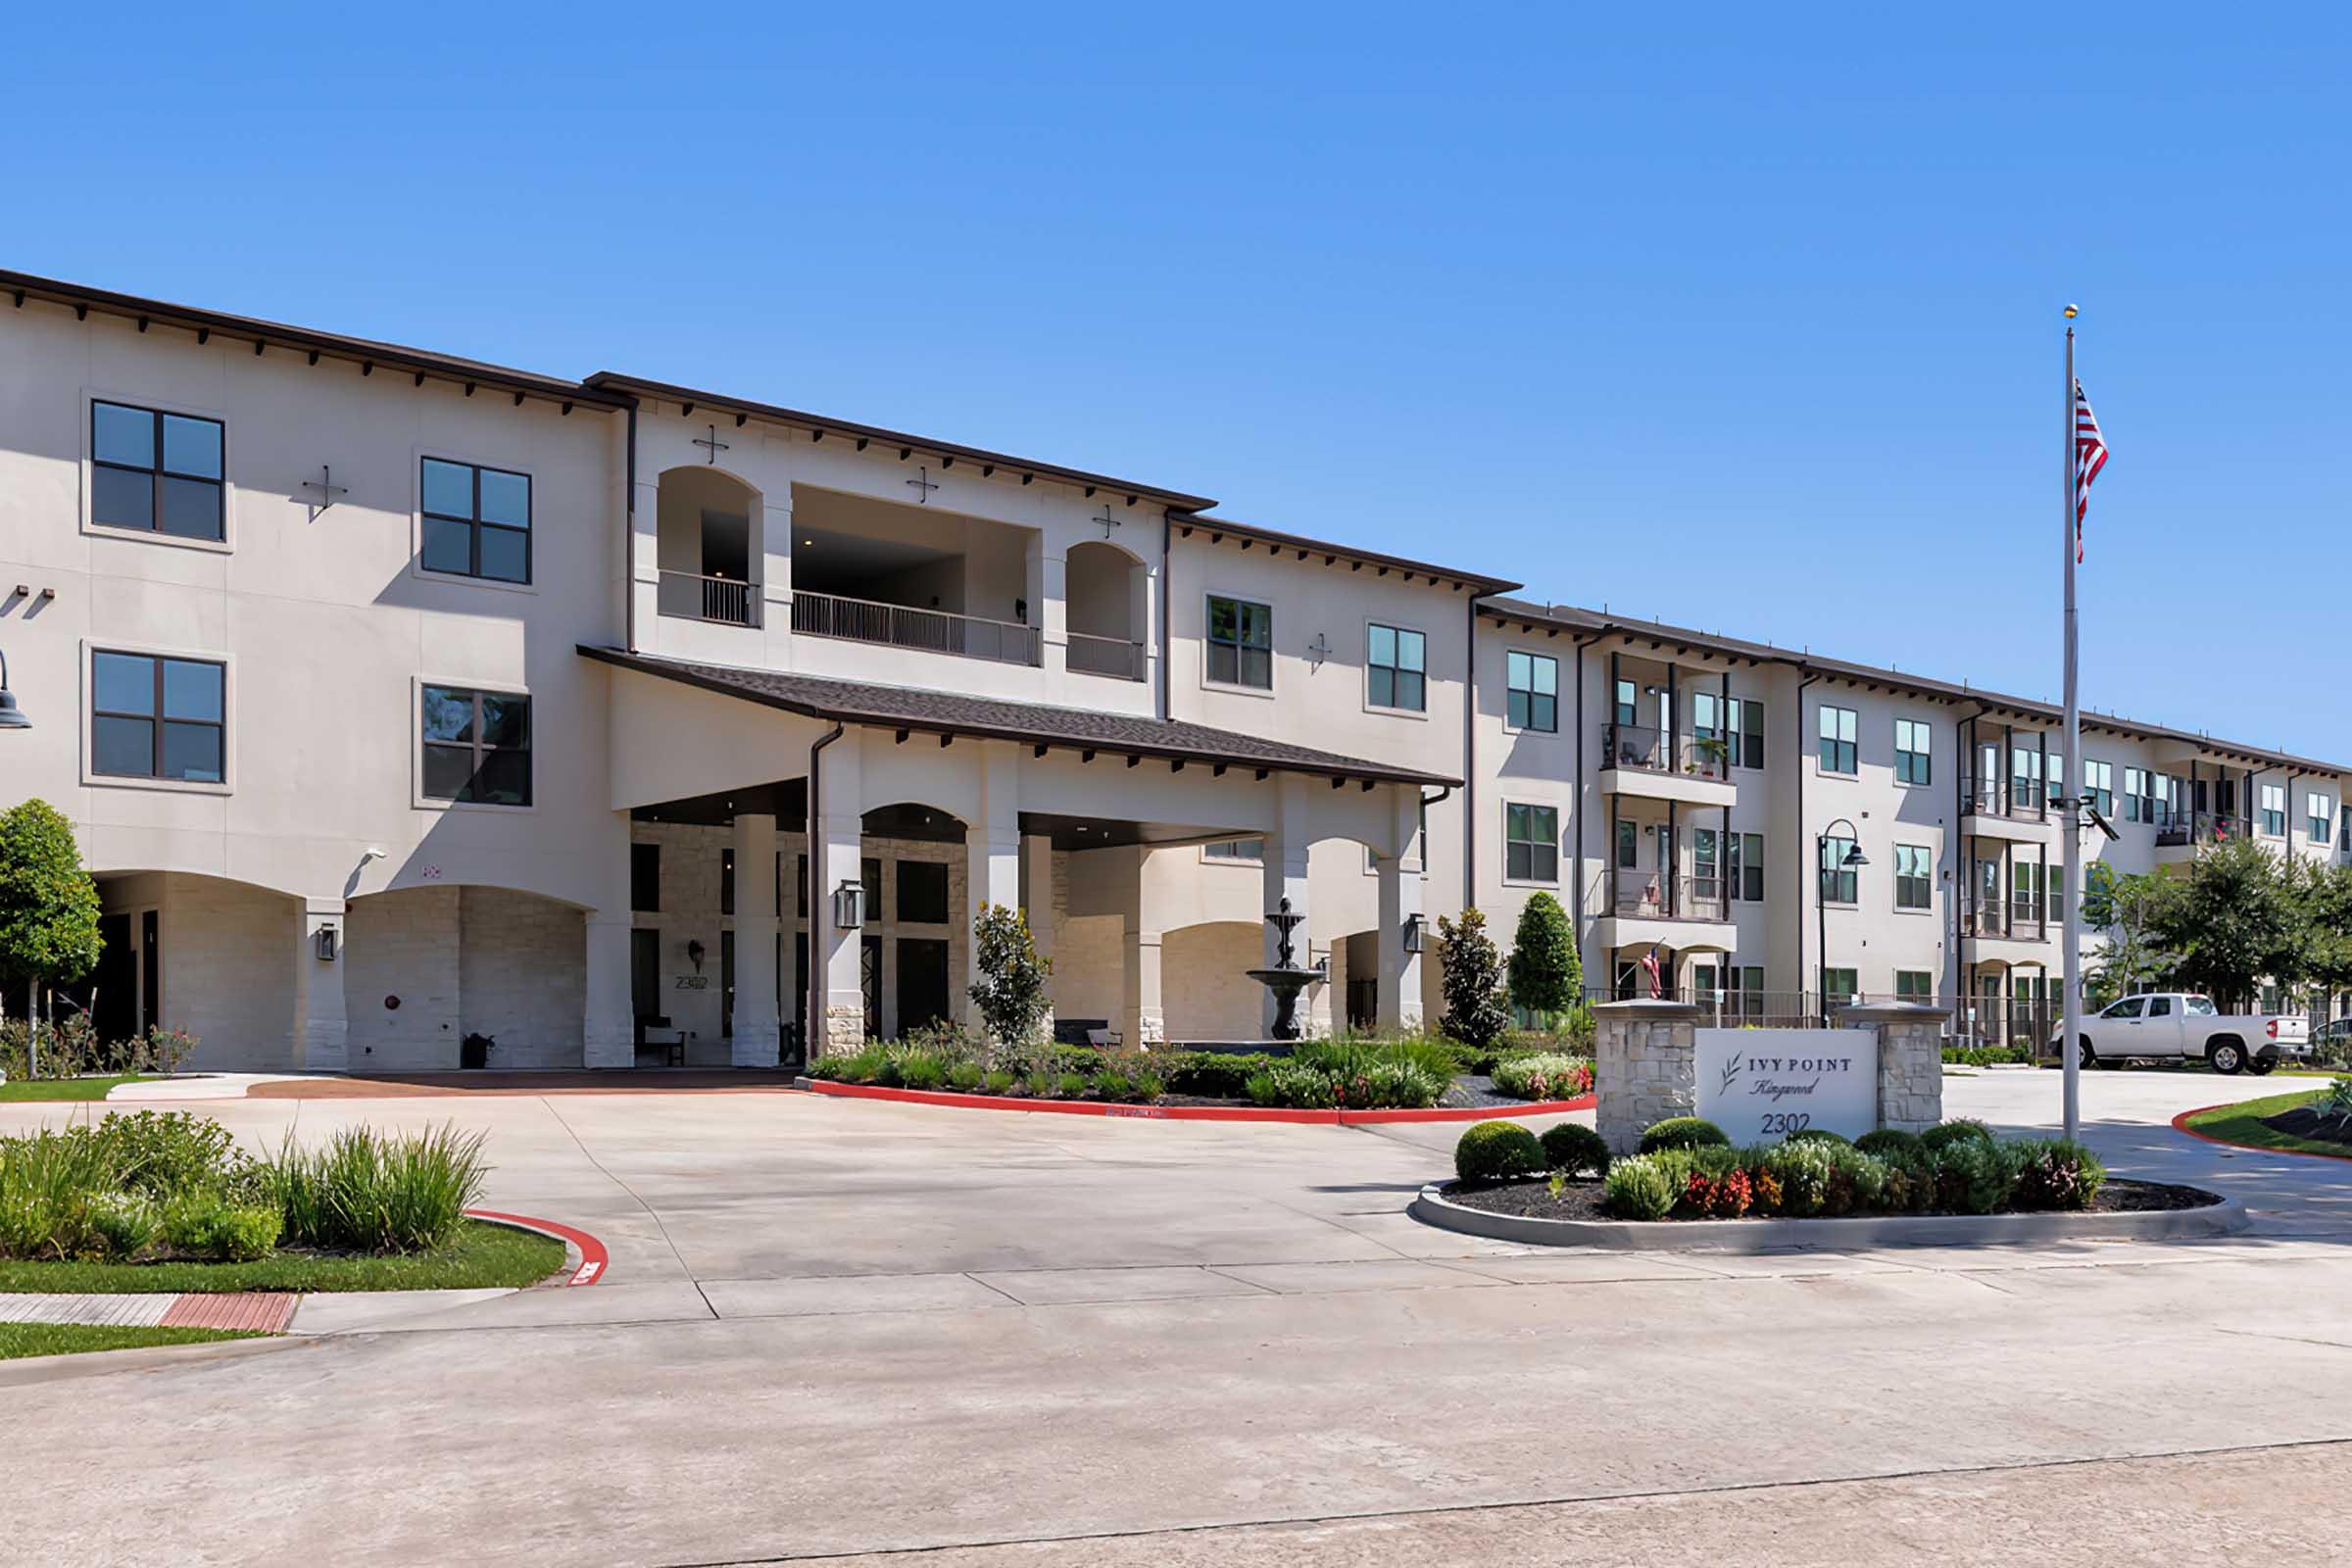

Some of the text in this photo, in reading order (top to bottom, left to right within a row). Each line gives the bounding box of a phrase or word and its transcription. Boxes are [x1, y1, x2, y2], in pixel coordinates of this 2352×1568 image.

[1748, 1057, 1851, 1071] IVY POINT
[1761, 1113, 1810, 1134] 2302
